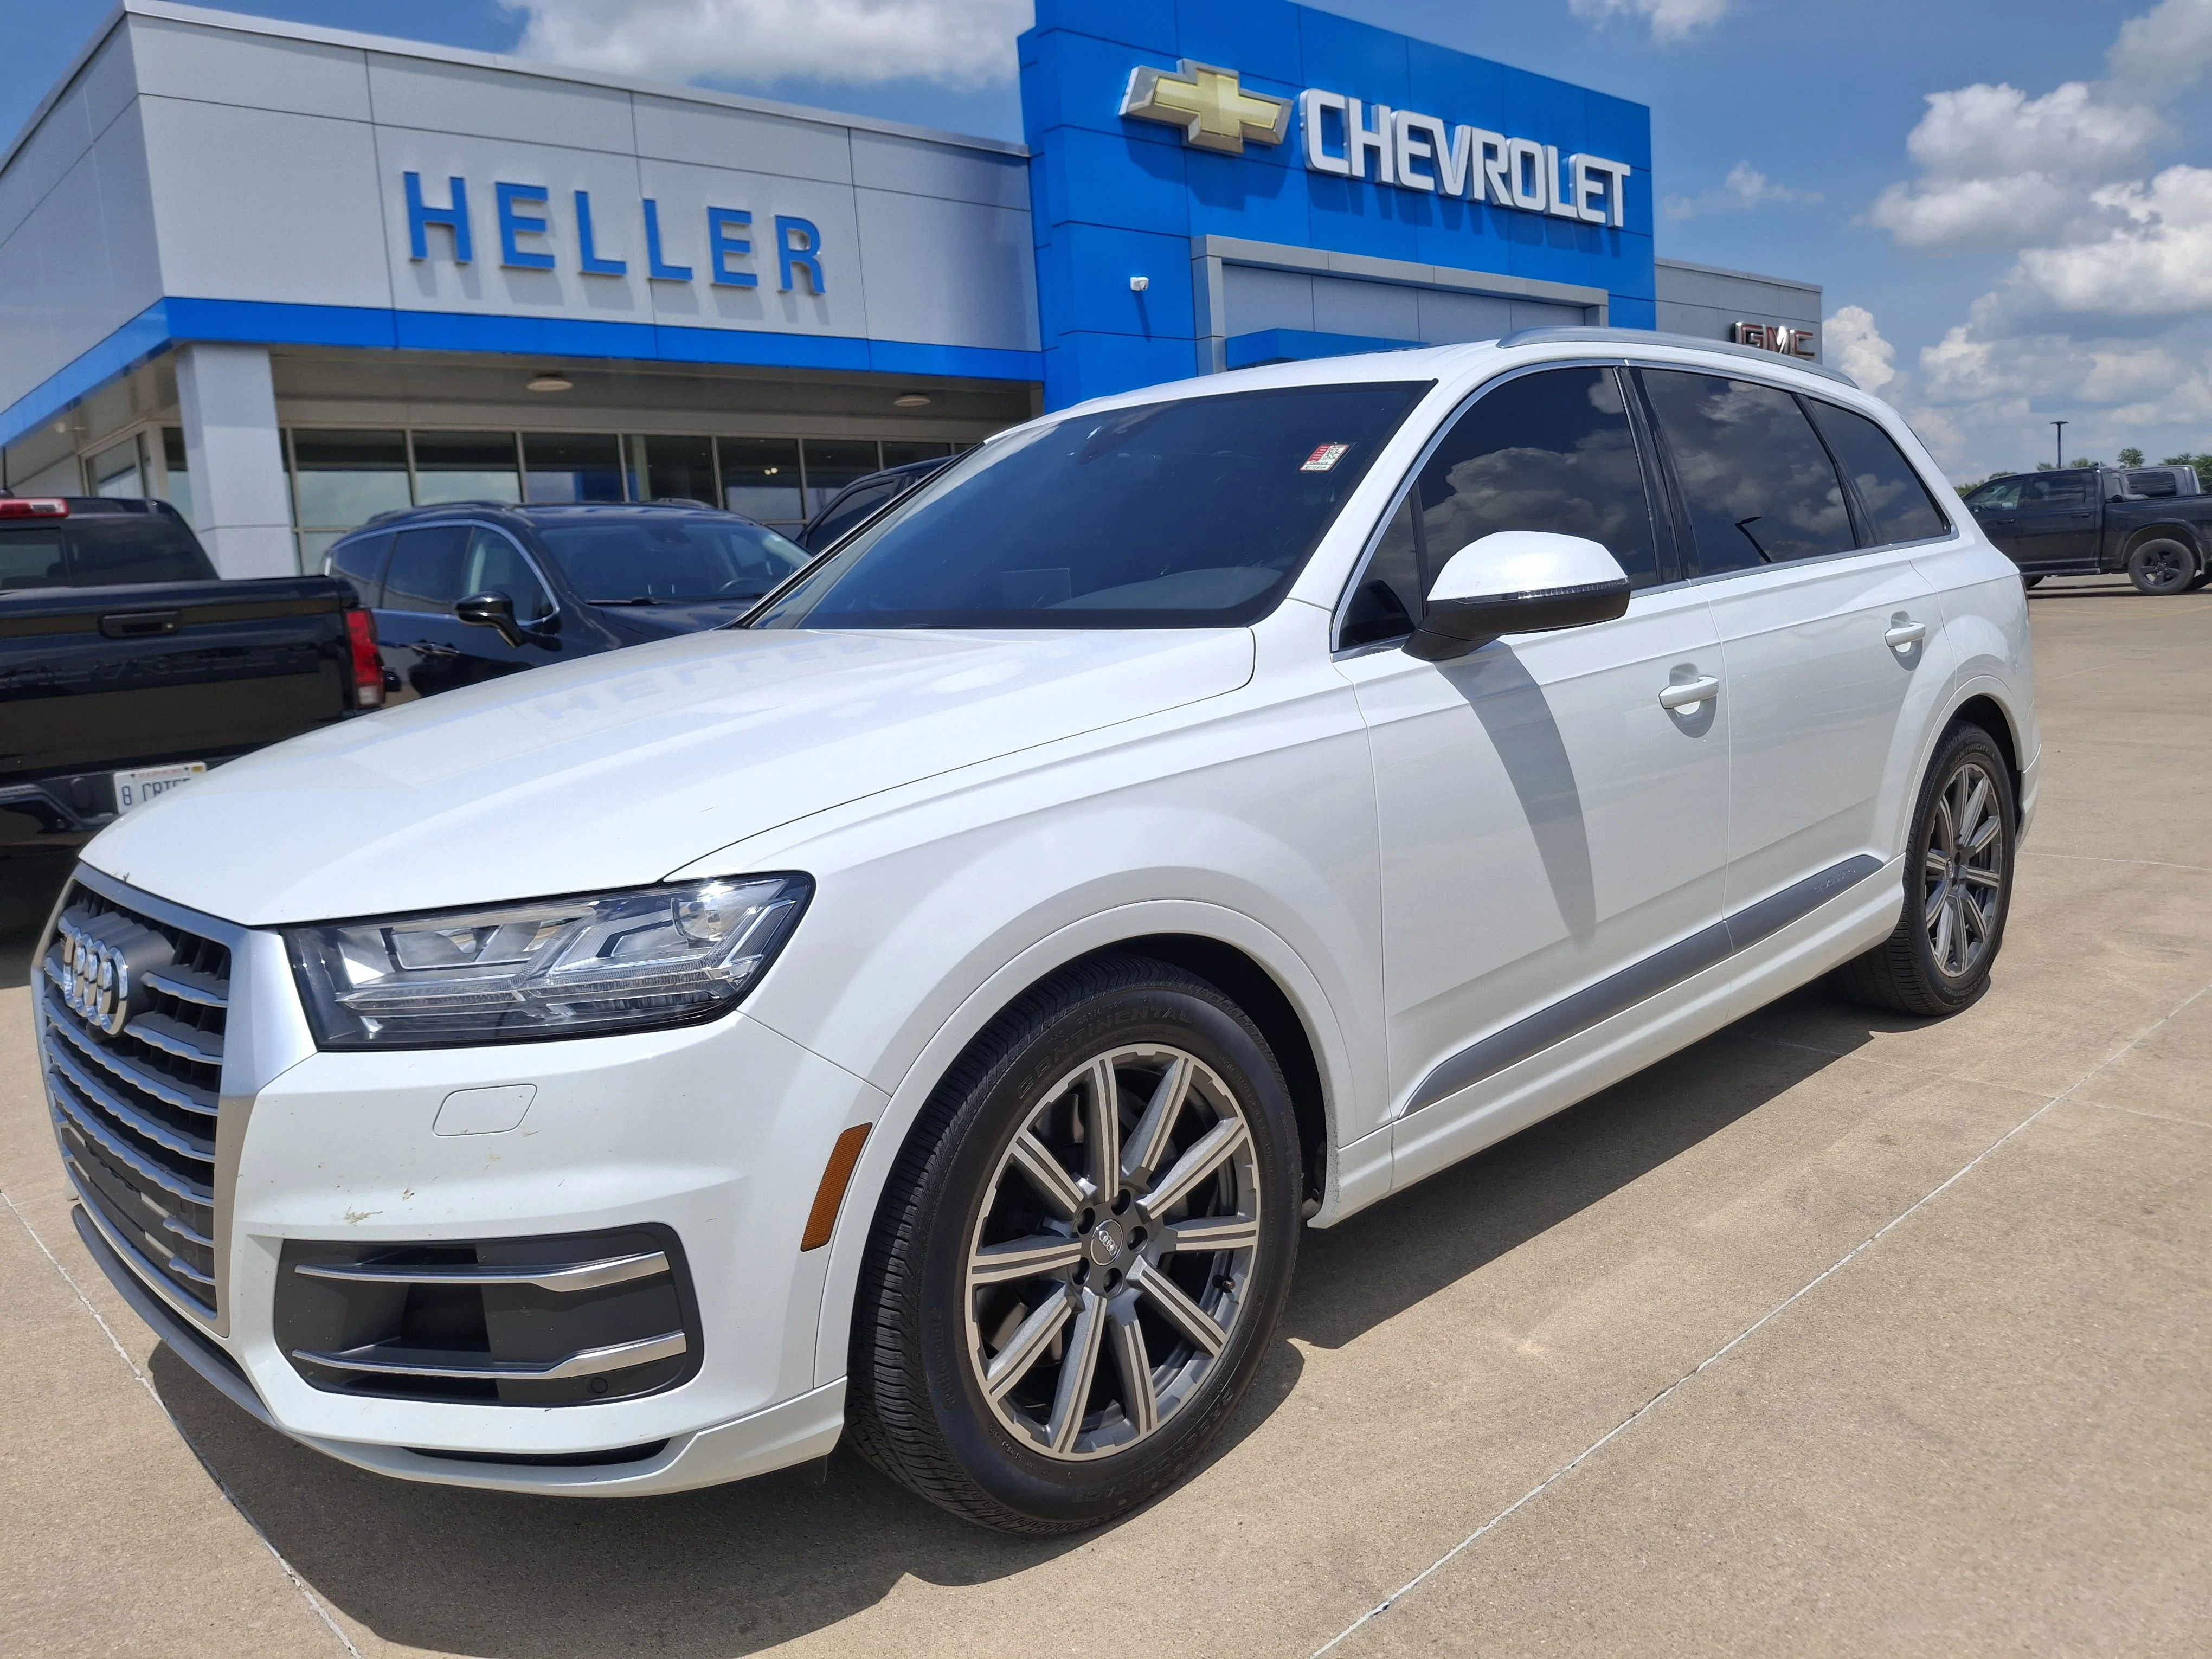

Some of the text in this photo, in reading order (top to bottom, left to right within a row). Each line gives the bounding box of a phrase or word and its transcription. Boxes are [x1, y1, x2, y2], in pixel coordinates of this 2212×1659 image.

[1301, 88, 1630, 228] CHEVROLET
[403, 171, 826, 295] HELLER
[1733, 321, 1815, 359] GMC
